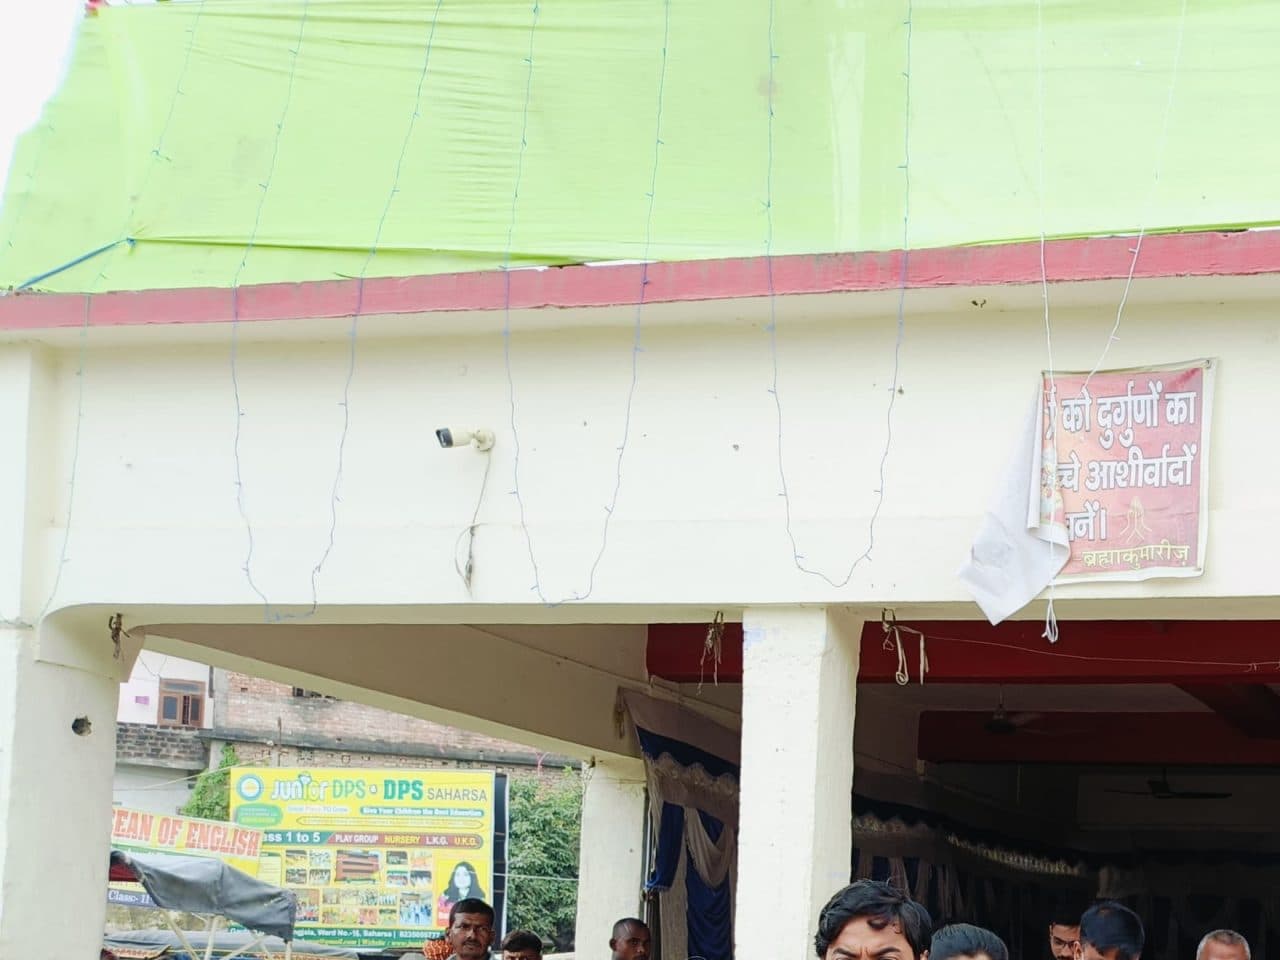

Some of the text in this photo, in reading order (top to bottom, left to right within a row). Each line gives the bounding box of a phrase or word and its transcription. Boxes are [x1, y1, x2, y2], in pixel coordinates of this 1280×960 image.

[1061, 386, 1093, 432] को
[1097, 381, 1163, 450] दुर्गुणों
[1165, 391, 1197, 425] का
[1085, 444, 1198, 491] आशीर्वादों
[332, 779, 366, 799] DPS
[383, 779, 424, 800] DPS
[427, 788, 488, 802] SAHARSA
[158, 817, 183, 845] OF
[185, 822, 262, 857] ENGLISH
[286, 831, 292, 842] 1
[296, 832, 309, 842] to
[313, 831, 321, 842] 5
[335, 834, 353, 843] PLAY
[353, 834, 378, 844] GROUP
